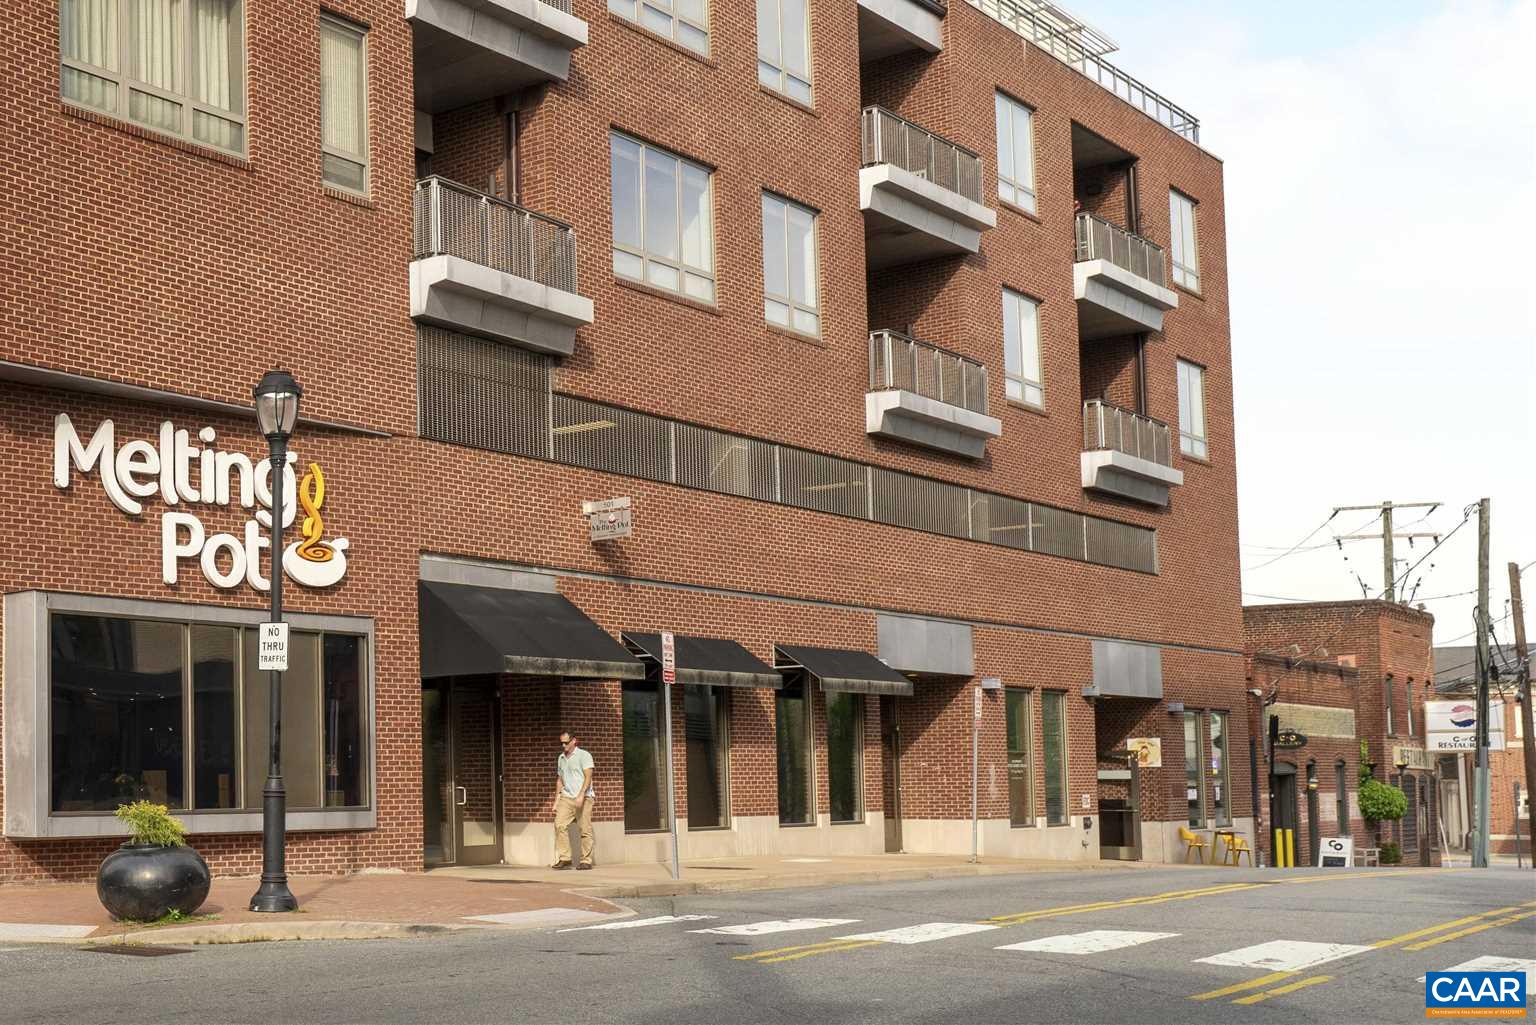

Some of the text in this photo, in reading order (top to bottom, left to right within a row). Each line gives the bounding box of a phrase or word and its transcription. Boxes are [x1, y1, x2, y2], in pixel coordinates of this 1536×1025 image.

[54, 413, 298, 528] Melting
[161, 511, 272, 591] Pot
[262, 641, 284, 651] THRU
[268, 627, 280, 636] NO
